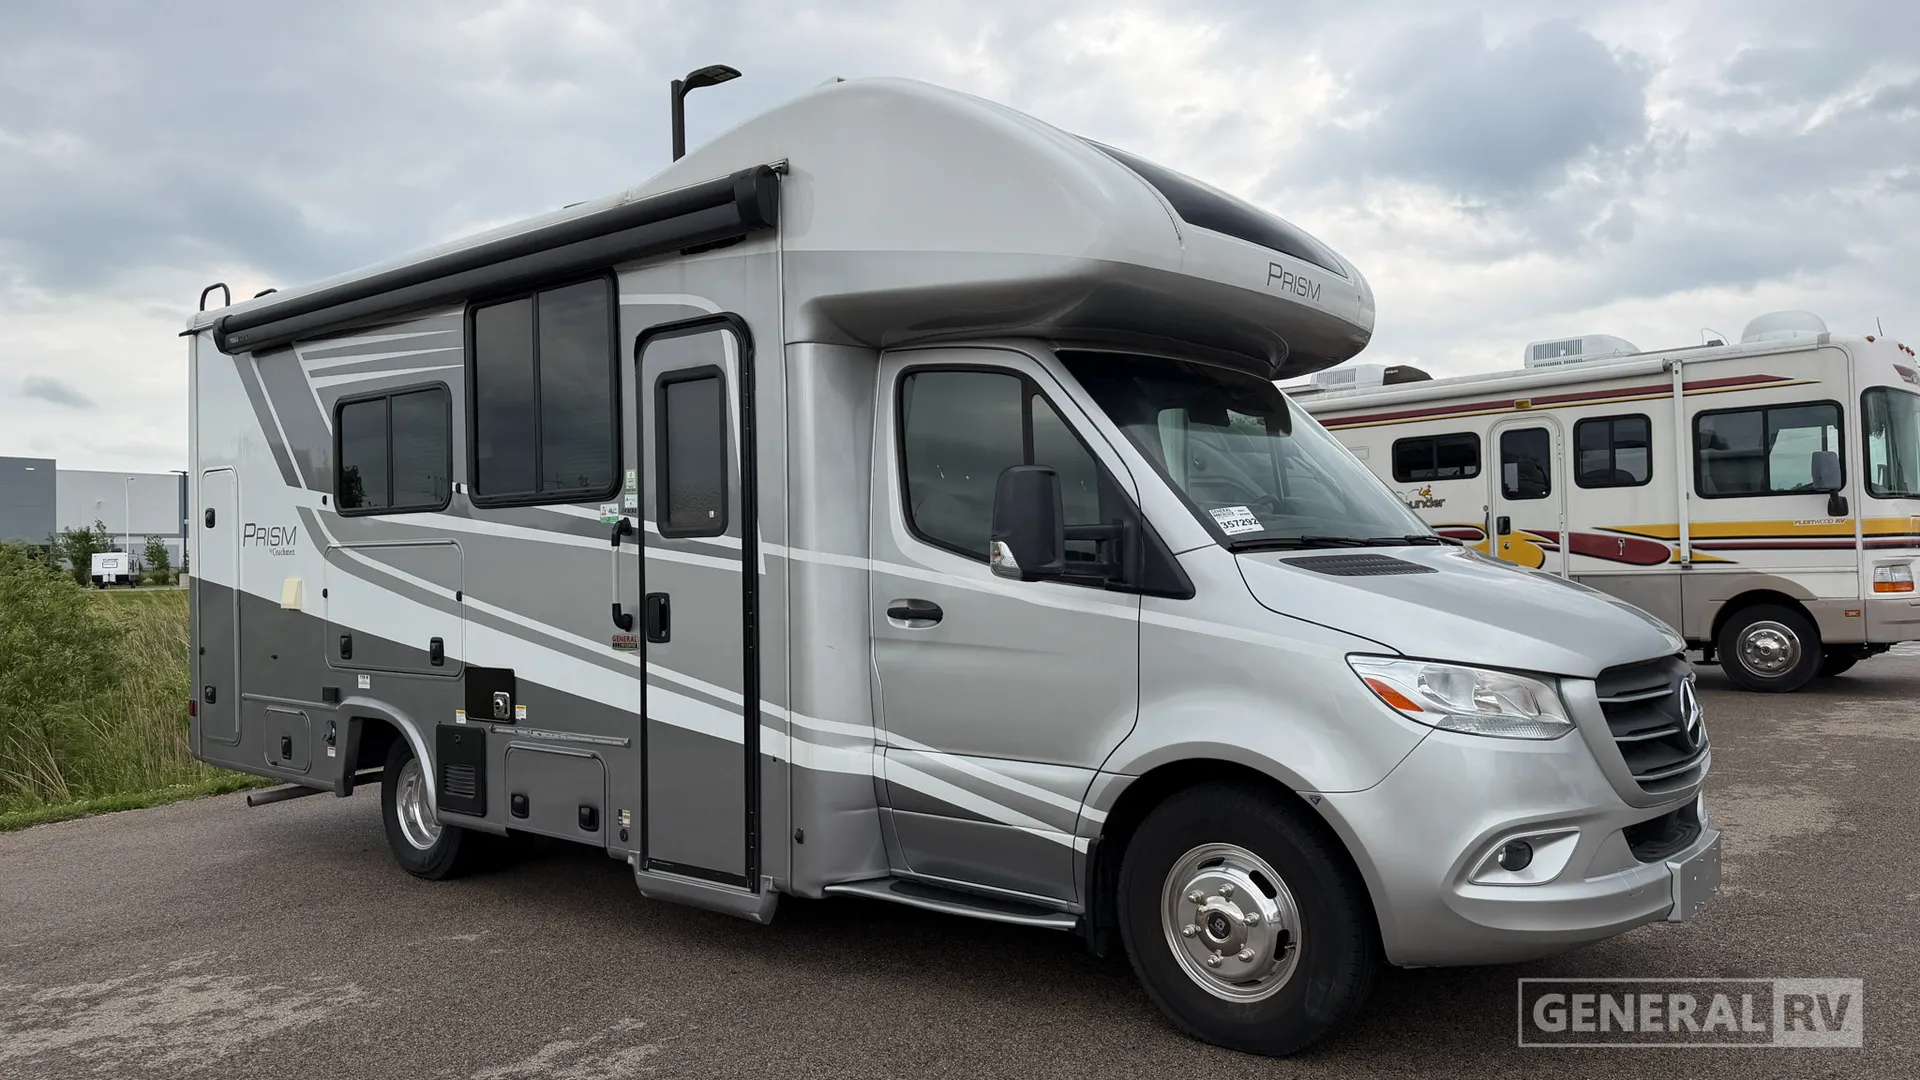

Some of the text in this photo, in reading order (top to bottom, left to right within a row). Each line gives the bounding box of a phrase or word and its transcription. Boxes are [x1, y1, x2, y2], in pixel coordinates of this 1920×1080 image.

[1266, 261, 1321, 302] PRISM
[1220, 518, 1259, 529] 357292
[242, 522, 297, 547] PRISM
[612, 635, 638, 643] GENERAL
